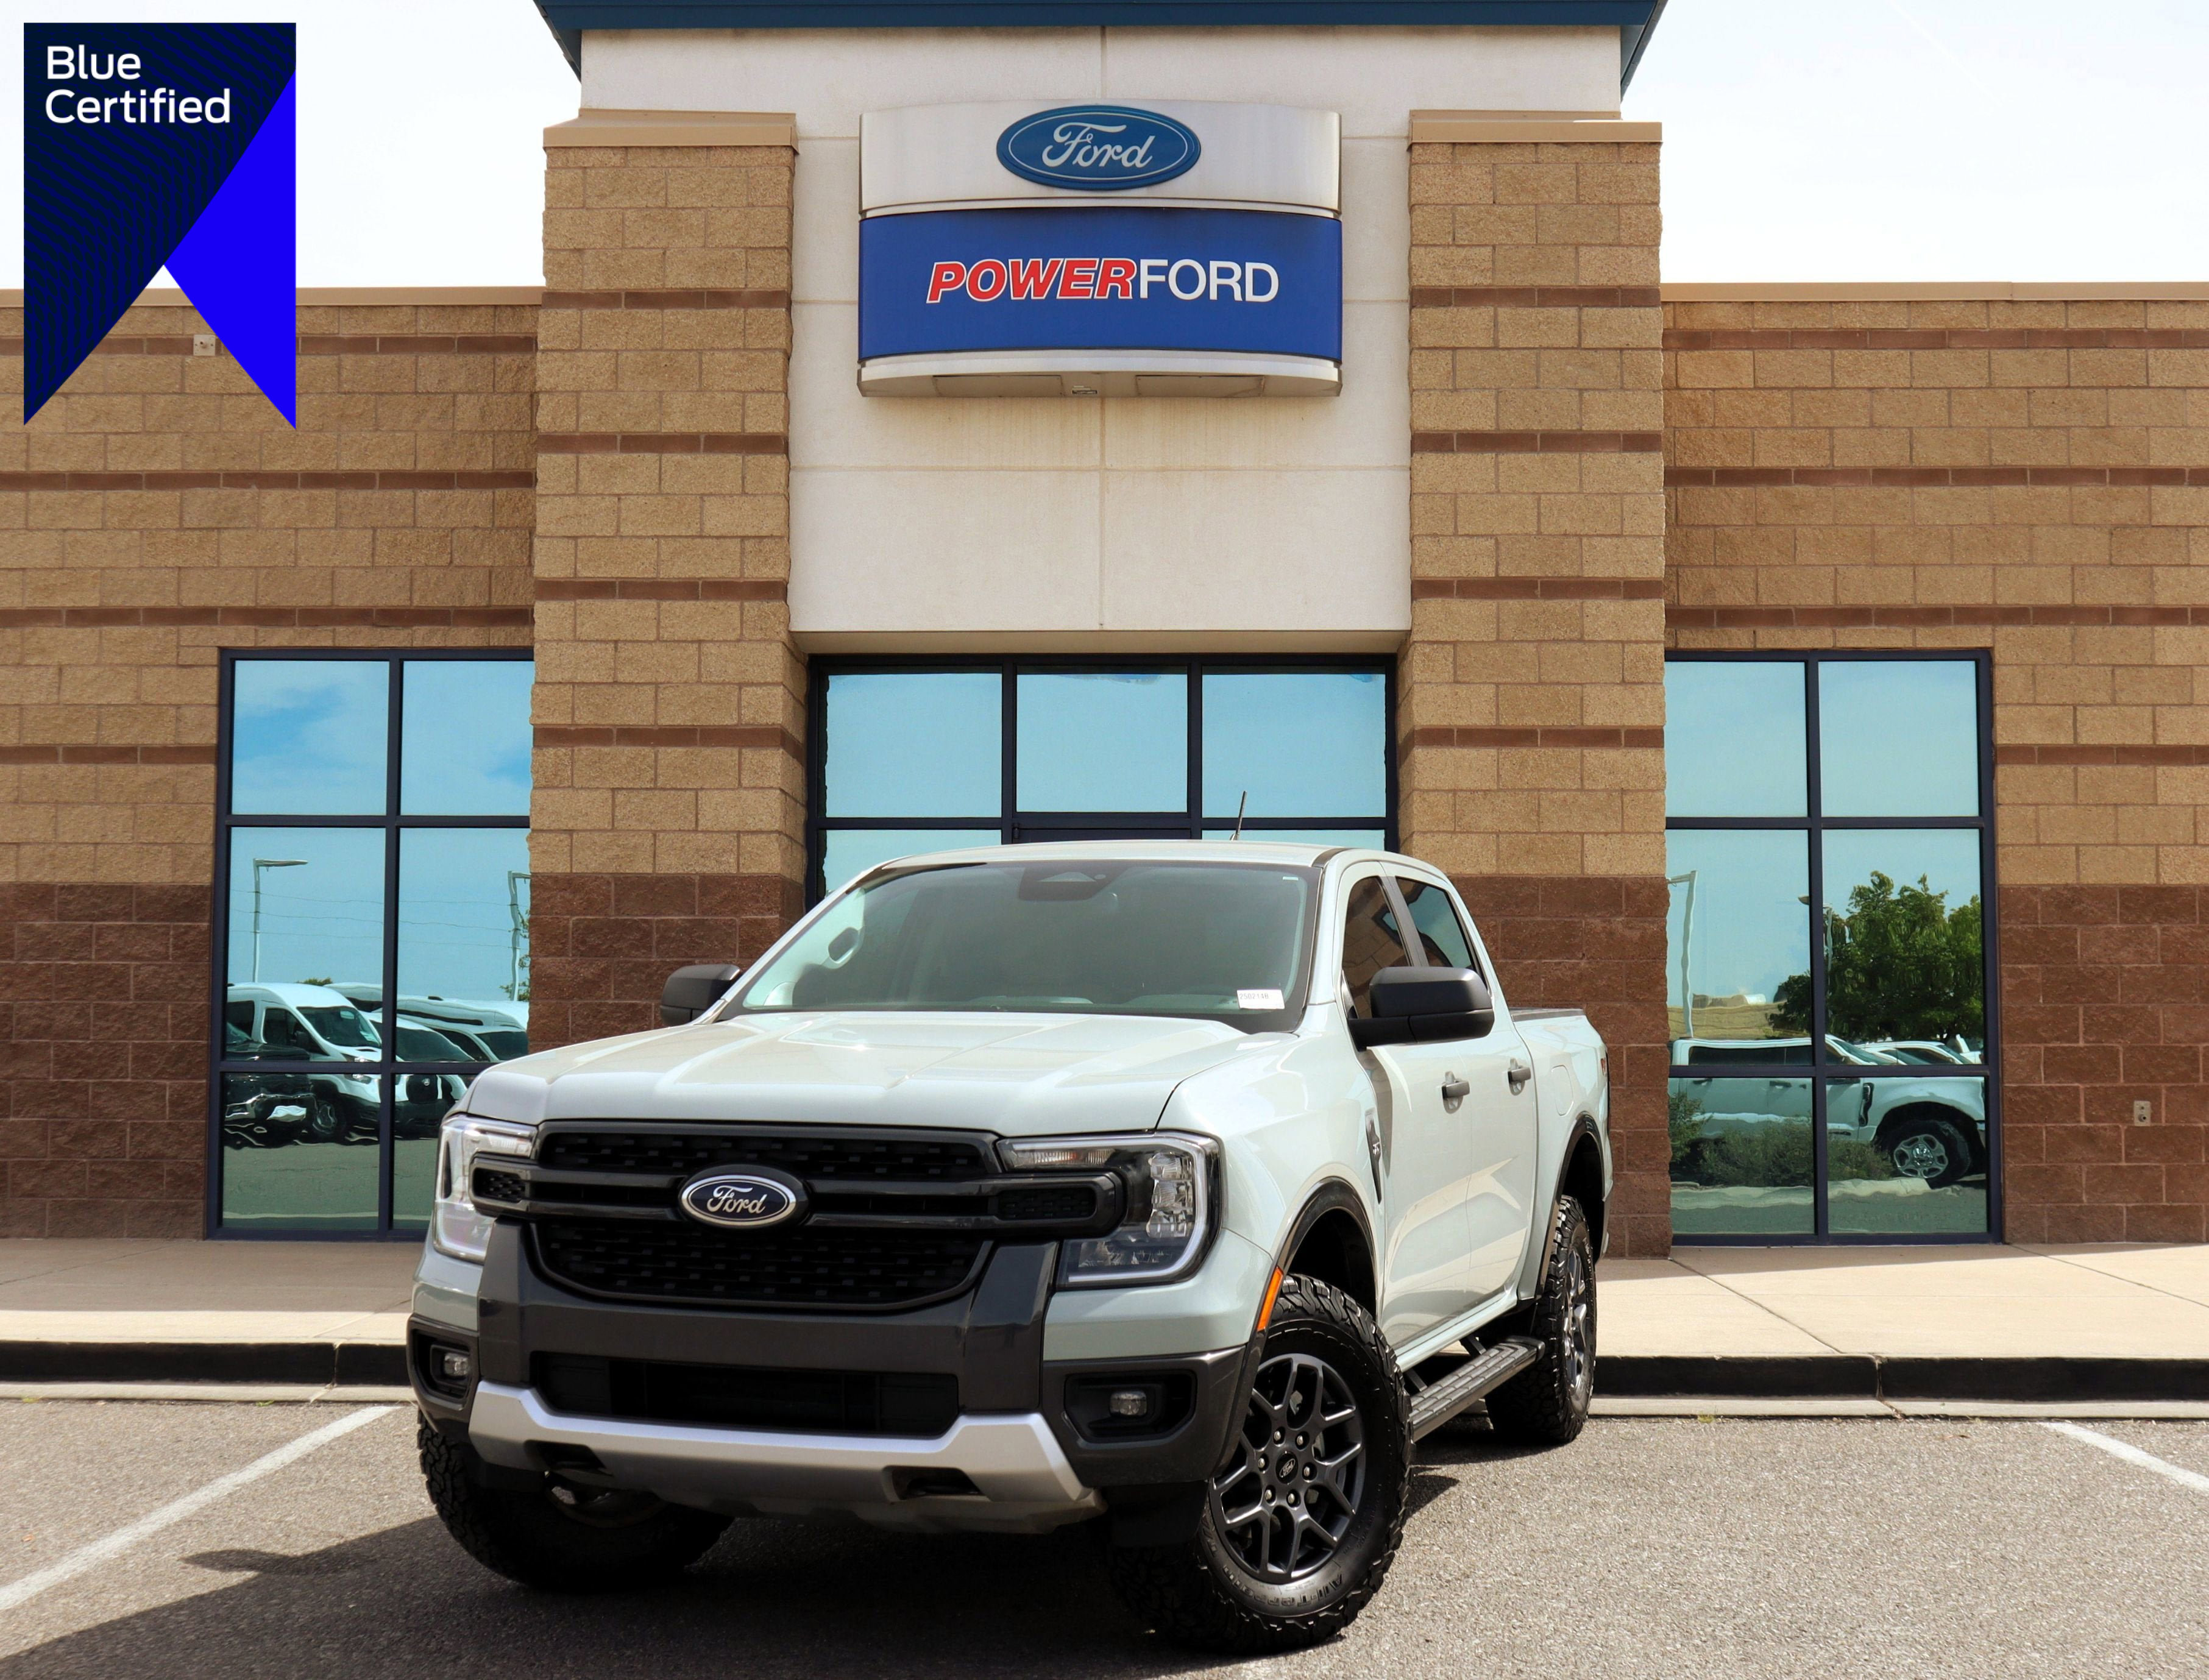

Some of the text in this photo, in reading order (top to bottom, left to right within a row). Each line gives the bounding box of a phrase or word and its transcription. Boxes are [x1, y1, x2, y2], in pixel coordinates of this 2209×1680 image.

[1041, 122, 1154, 169] Ford
[926, 258, 1279, 303] POWERFORD
[707, 1185, 767, 1214] Ford
